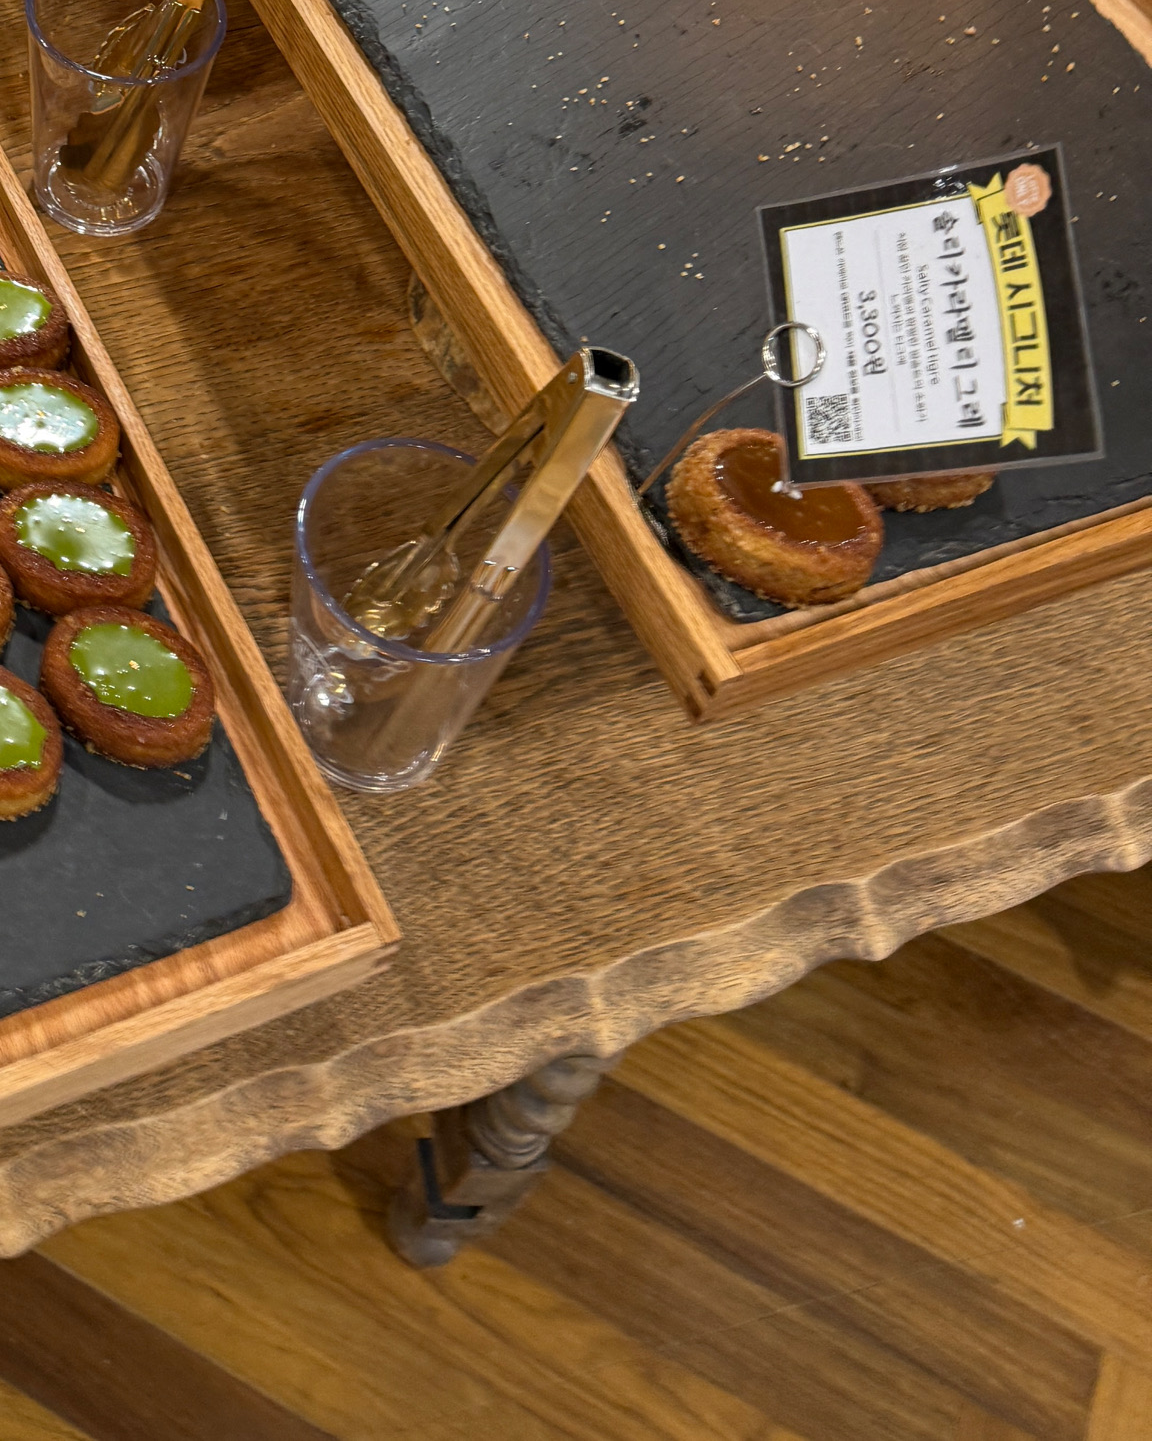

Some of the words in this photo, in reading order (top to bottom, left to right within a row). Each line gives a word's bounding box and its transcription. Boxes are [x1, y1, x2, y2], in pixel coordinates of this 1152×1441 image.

[992, 211, 1026, 272] 롯데
[915, 264, 931, 296] Salty
[857, 290, 887, 376] 3,300원
[922, 298, 937, 352] Caramel
[1008, 283, 1043, 405] 시그니처
